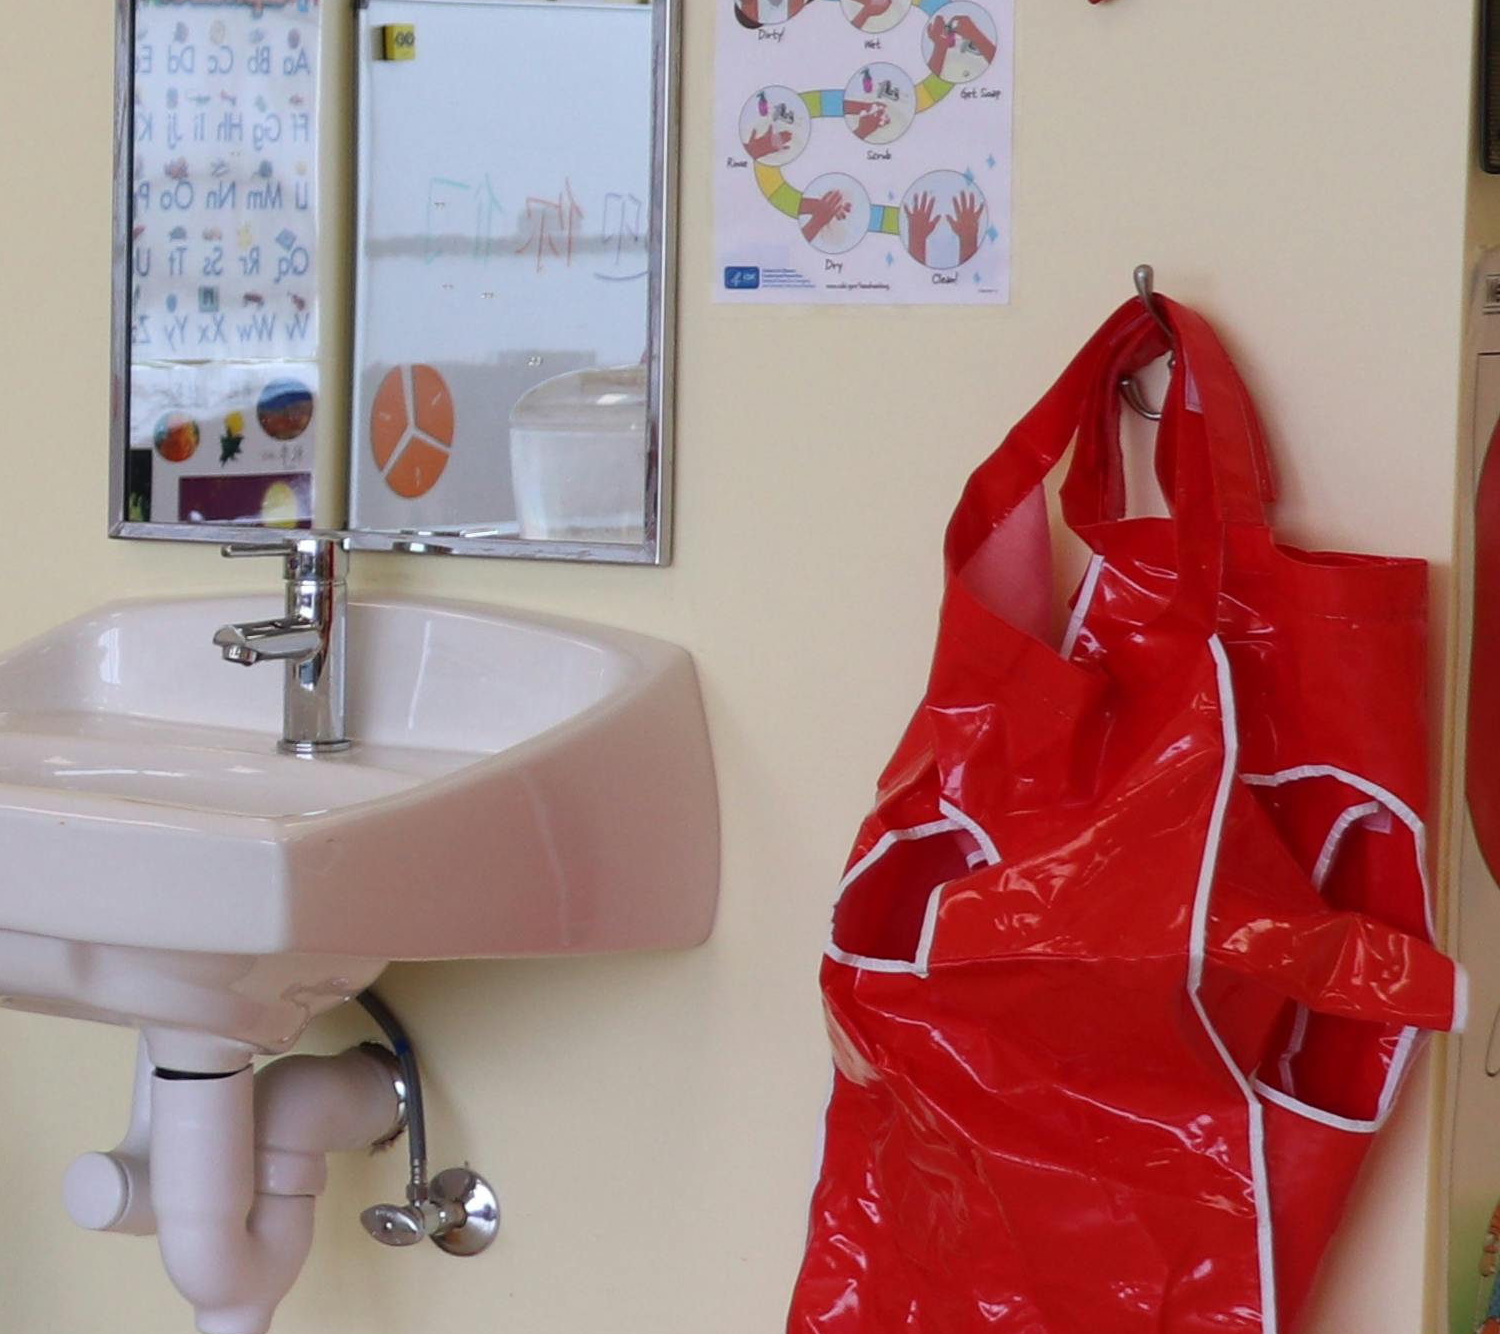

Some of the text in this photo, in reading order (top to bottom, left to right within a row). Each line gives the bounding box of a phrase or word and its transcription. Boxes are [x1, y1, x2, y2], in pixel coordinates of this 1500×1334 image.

[960, 87, 978, 100] Get
[867, 150, 892, 162] Scrub
[825, 258, 844, 273] Dry
